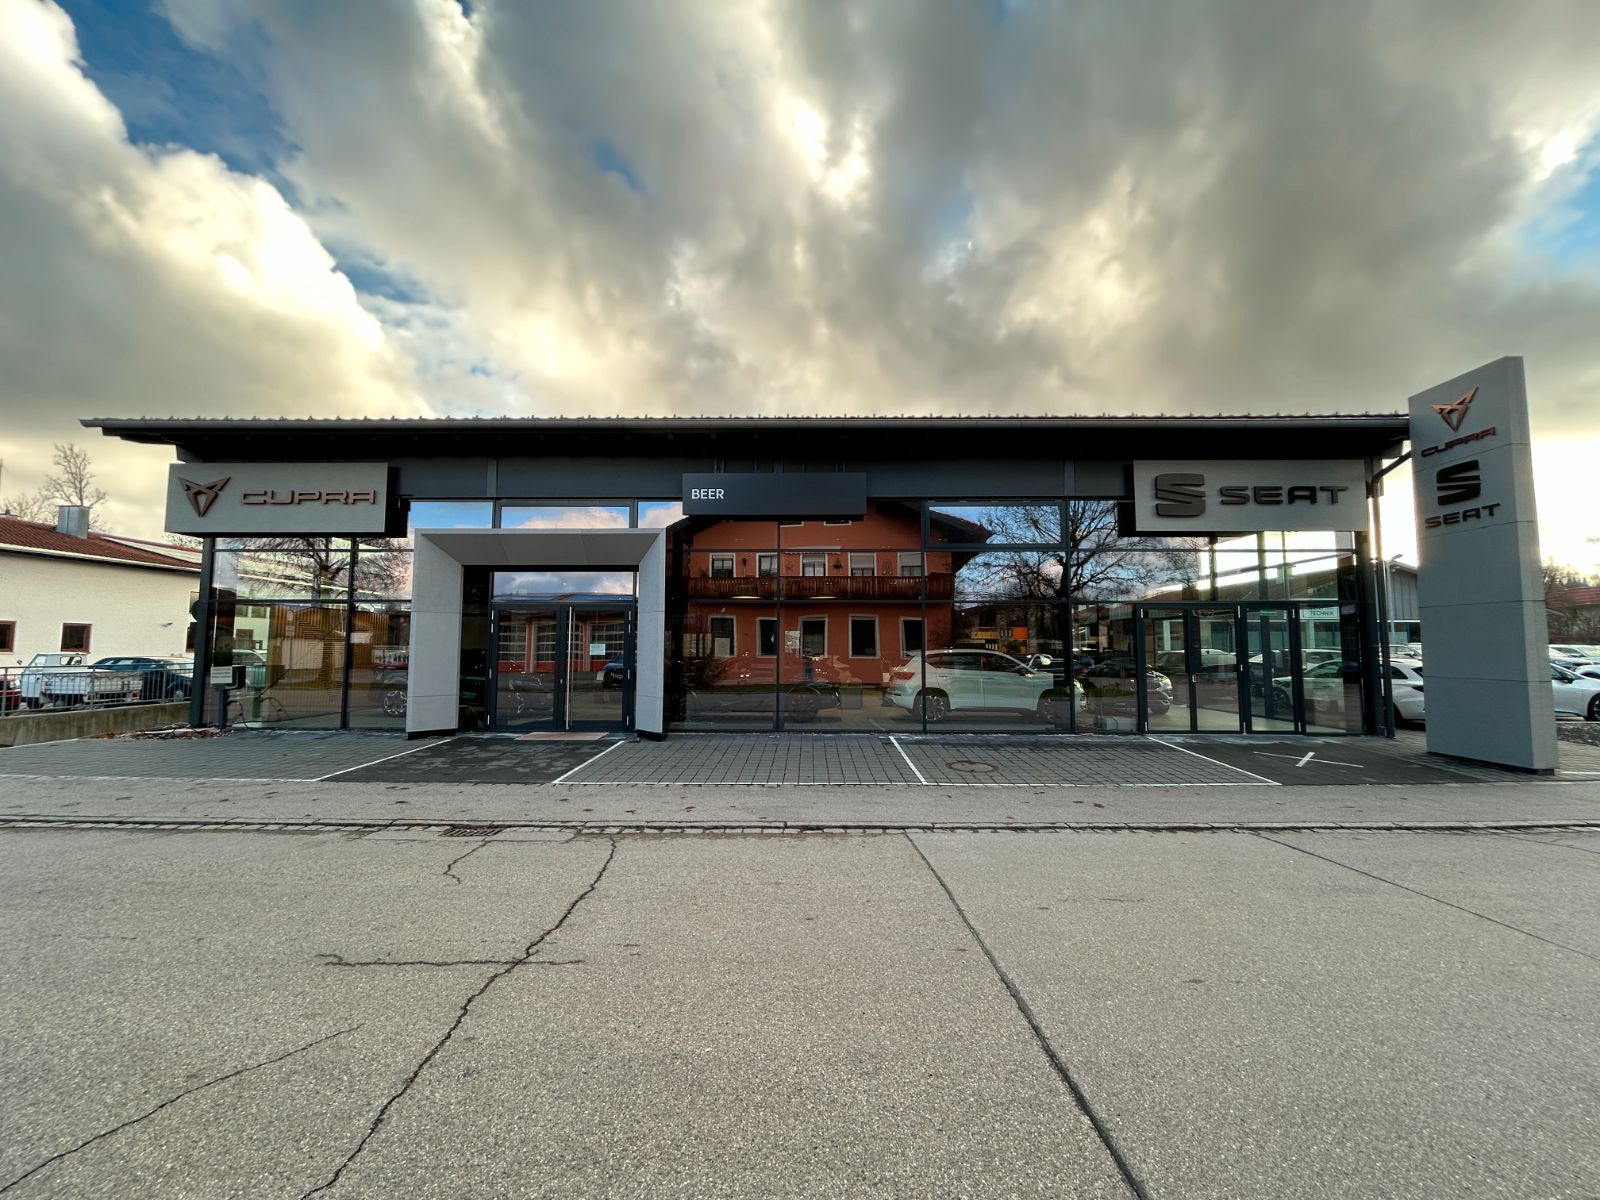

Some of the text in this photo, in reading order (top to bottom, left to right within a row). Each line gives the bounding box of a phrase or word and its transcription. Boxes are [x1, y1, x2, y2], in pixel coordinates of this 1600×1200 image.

[1421, 427, 1496, 458] CUPRA
[240, 489, 377, 506] CUPRA
[691, 488, 725, 500] BEER
[1219, 485, 1349, 506] SEAT
[1424, 503, 1501, 529] SEAT
